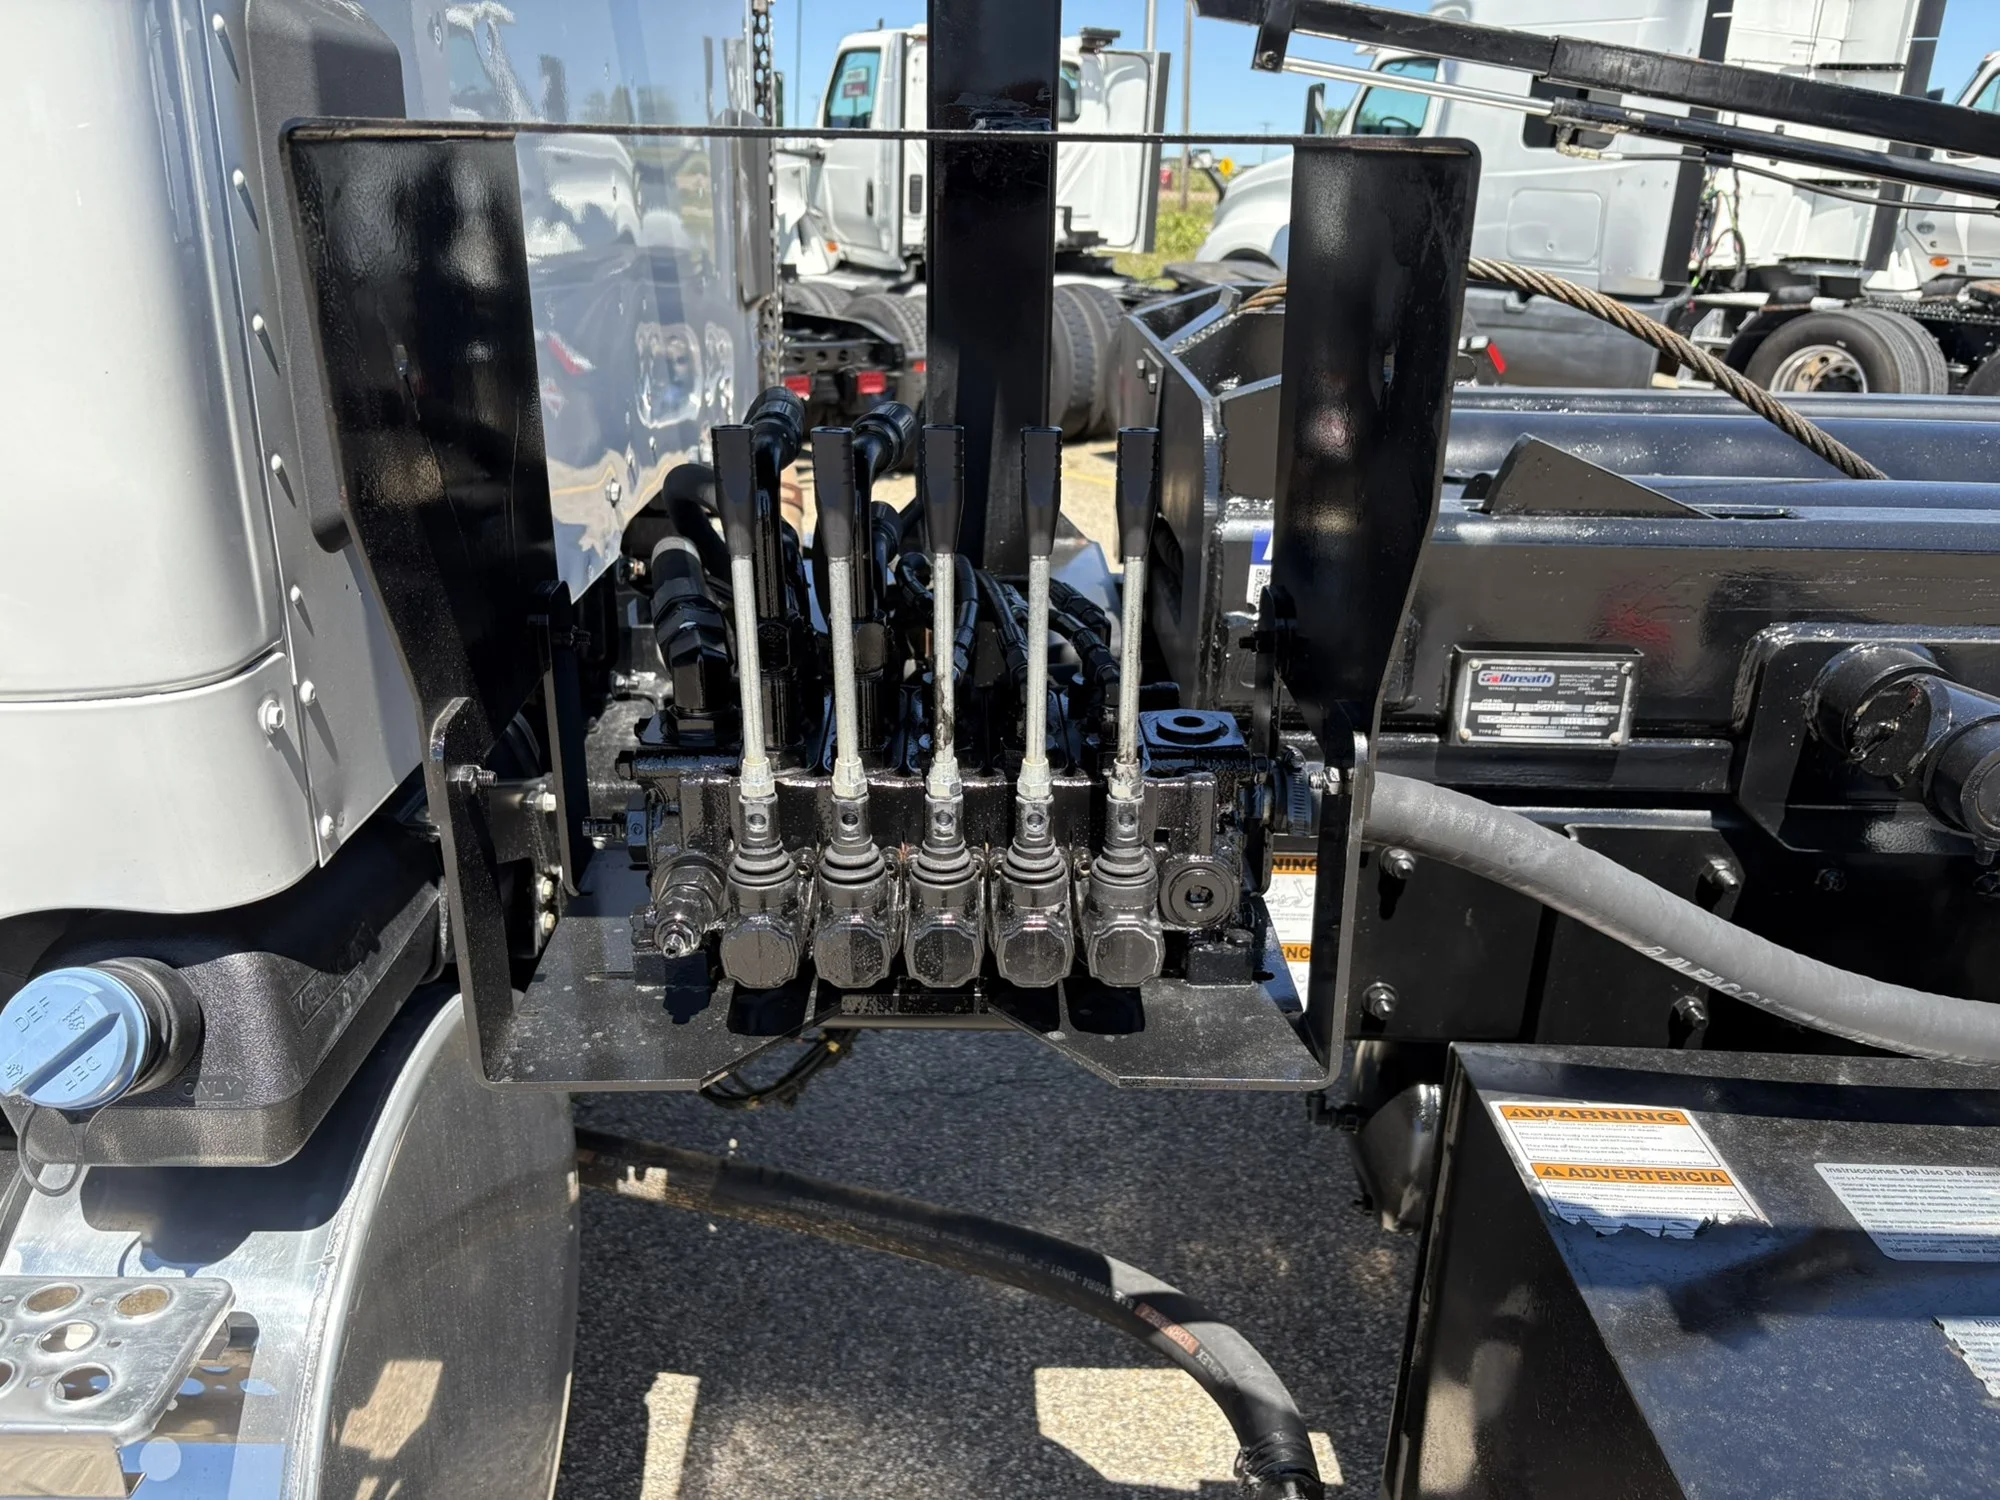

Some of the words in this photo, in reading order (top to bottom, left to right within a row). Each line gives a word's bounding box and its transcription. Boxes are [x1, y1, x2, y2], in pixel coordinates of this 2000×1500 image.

[1481, 673, 1552, 684] Galbreath
[1272, 857, 1317, 871] NING
[12, 996, 52, 1033] DEF
[63, 1055, 102, 1092] DEF
[182, 1081, 240, 1099] ONLY
[1526, 1108, 1681, 1123] WARNING
[1568, 1167, 1726, 1183] ADVERTENCIA
[1824, 1166, 1899, 1175] Instrucciones
[1920, 1168, 1944, 1176] Uso
